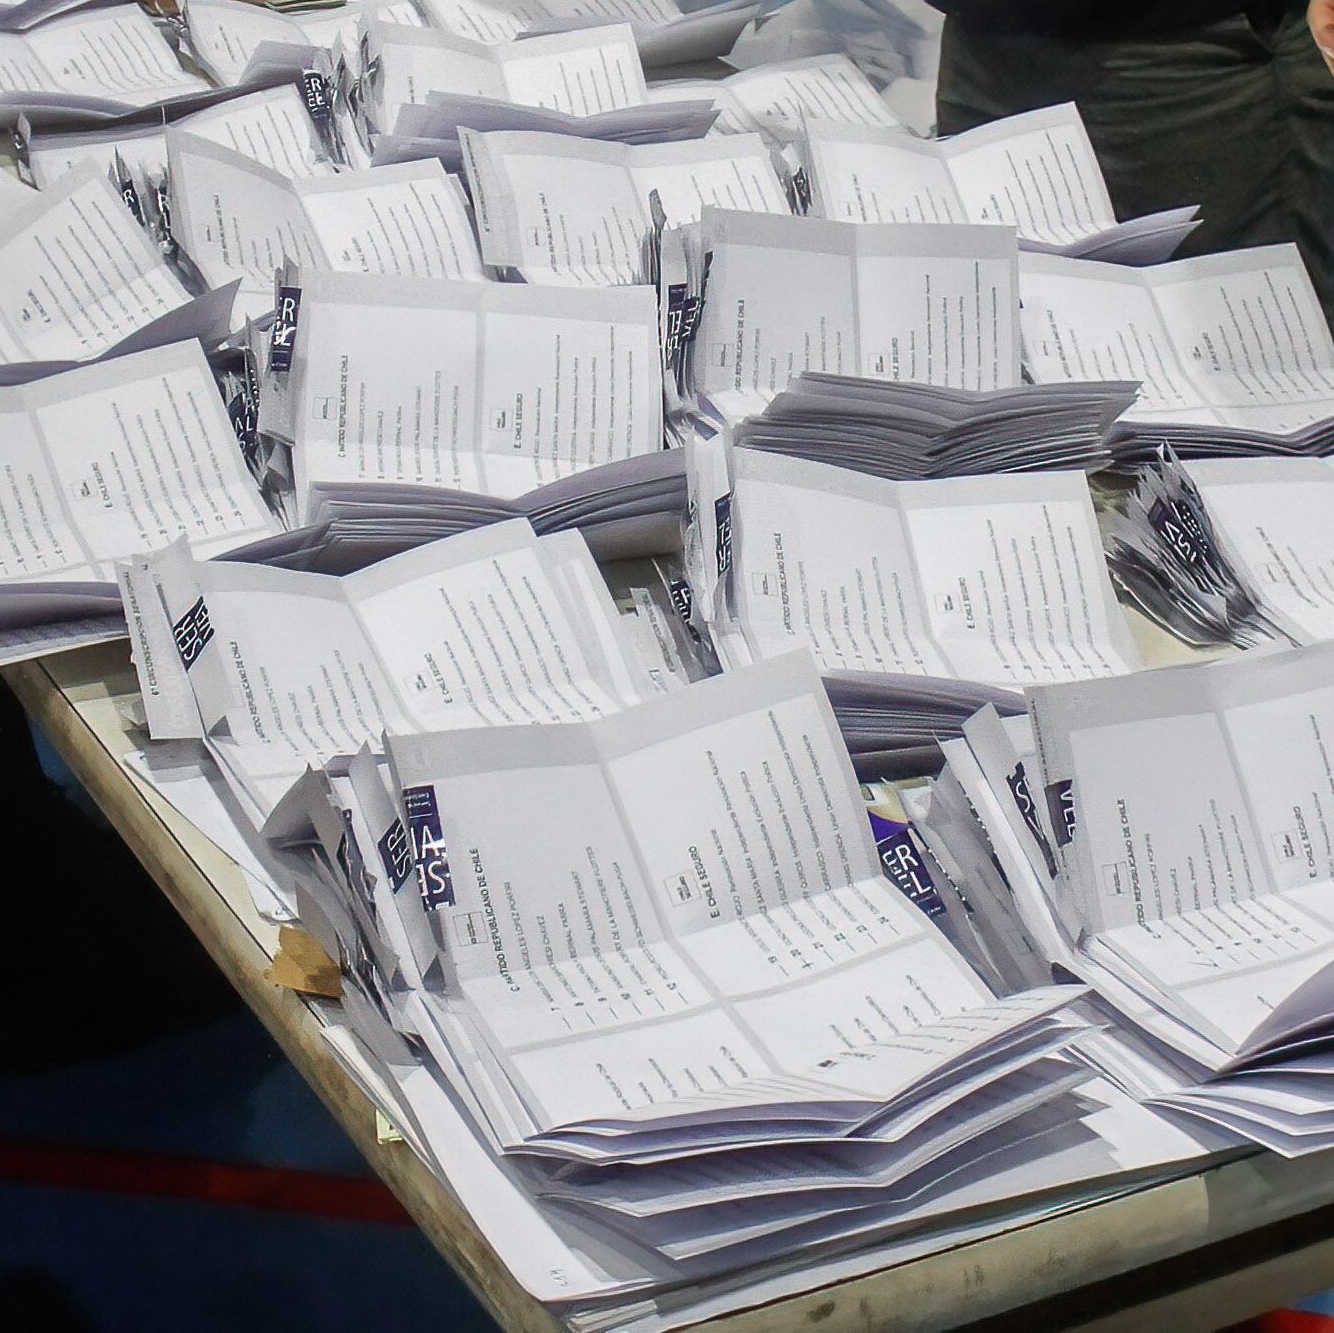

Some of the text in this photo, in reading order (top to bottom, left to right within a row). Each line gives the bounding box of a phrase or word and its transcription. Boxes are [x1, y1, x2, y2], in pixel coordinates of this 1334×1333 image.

[470, 848, 483, 874] CHILE
[687, 844, 707, 880] SEGURO
[476, 874, 486, 886] DE
[701, 881, 717, 907] CHILE
[479, 888, 503, 951] REPUBLICANO
